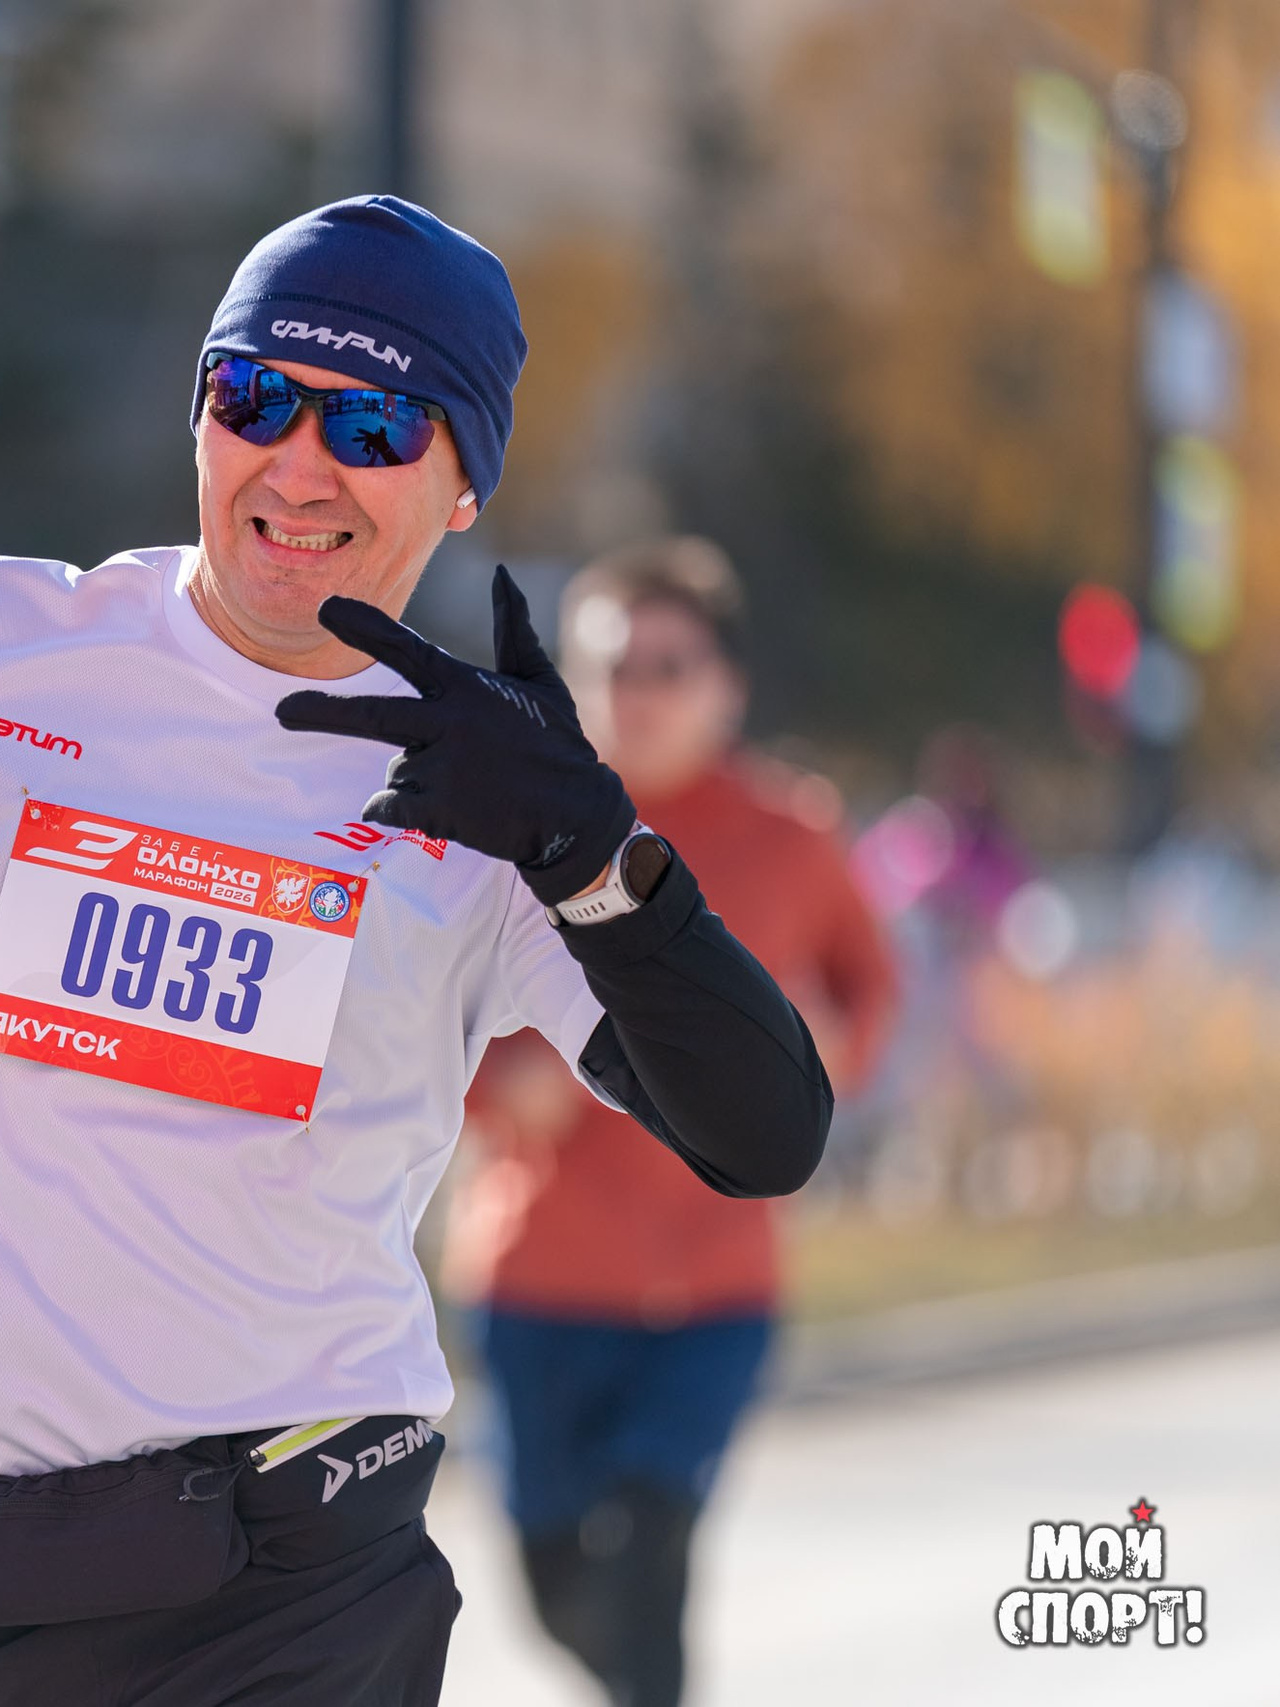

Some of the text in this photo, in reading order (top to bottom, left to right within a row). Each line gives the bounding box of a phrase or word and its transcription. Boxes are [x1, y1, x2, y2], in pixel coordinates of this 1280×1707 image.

[136, 846, 261, 889] ОЛОНХО
[140, 834, 224, 861] ЗАБЕГ
[133, 866, 252, 903] МАРАФОН 2026
[61, 892, 274, 1035] 0933
